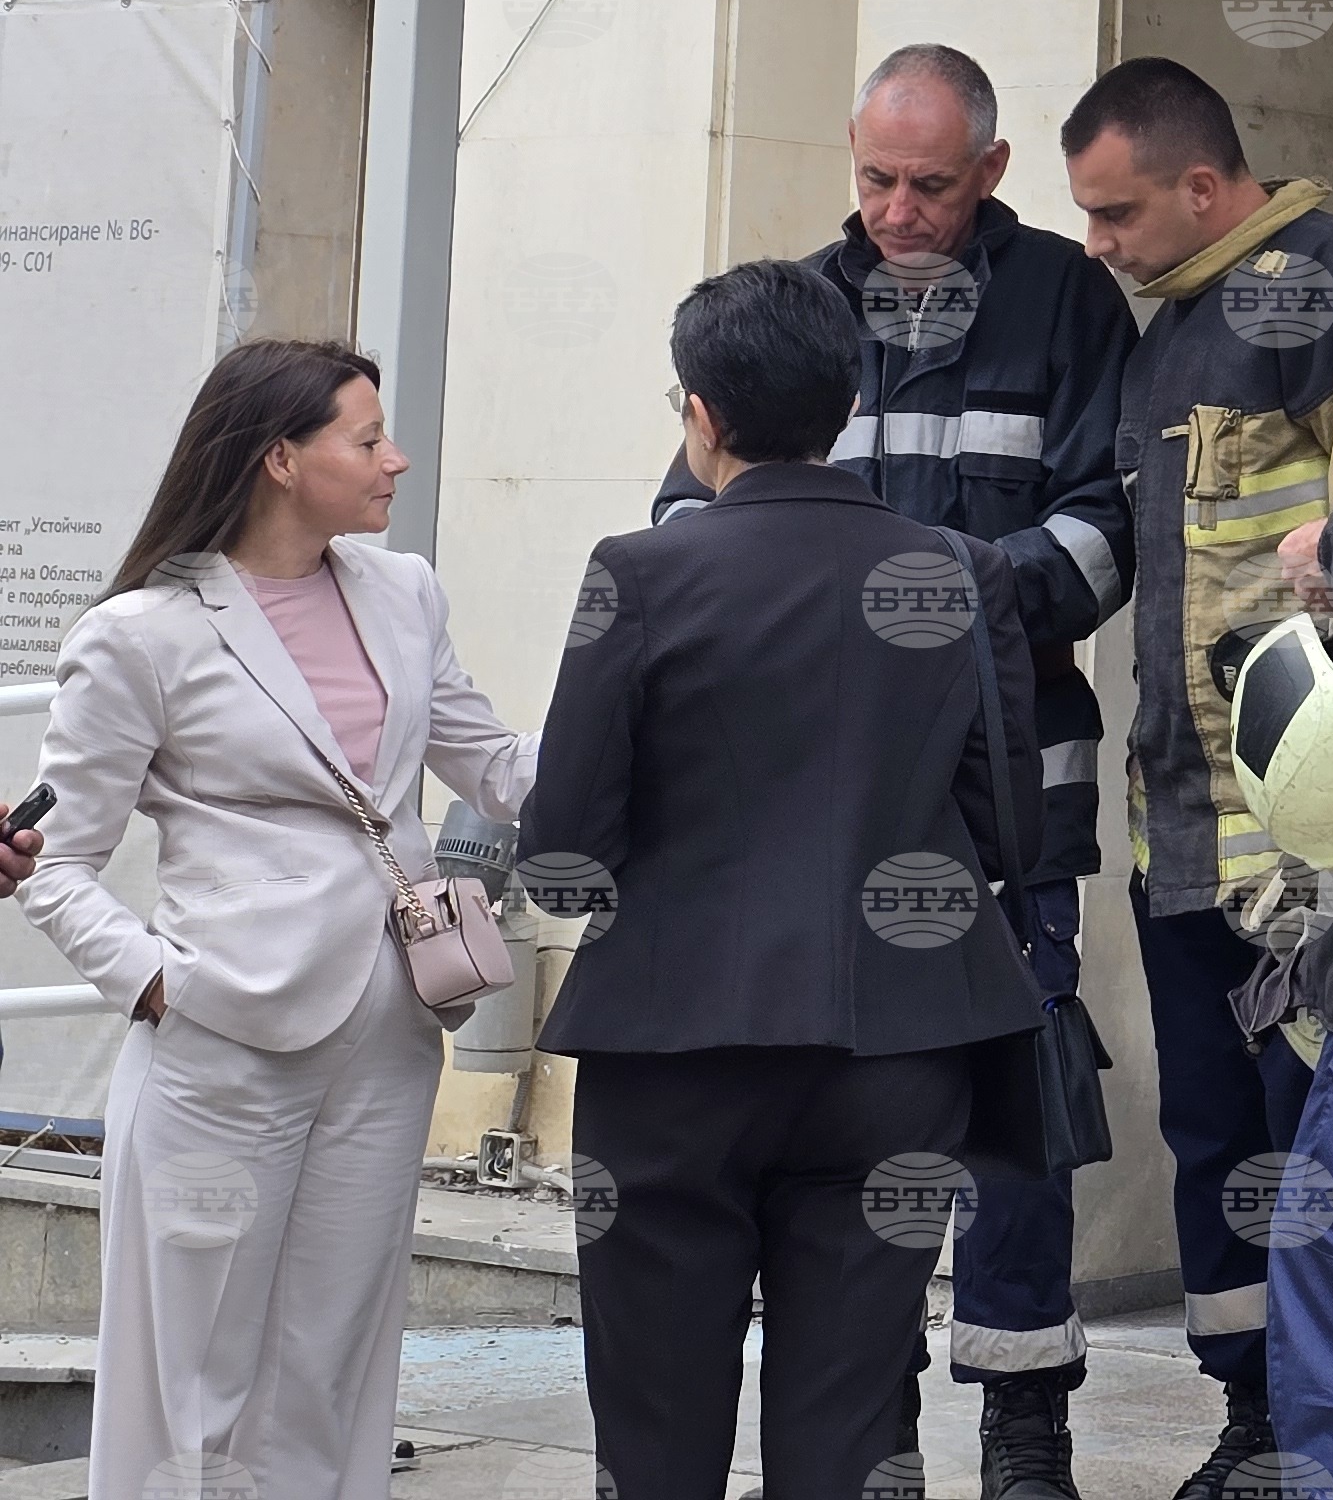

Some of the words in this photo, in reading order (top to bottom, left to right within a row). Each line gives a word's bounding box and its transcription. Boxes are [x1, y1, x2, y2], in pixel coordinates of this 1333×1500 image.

[106, 219, 123, 241] №
[129, 218, 160, 241] BG-
[0, 251, 17, 272] 9-
[7, 544, 23, 556] на
[20, 568, 36, 580] на
[39, 564, 103, 582] Областна
[45, 617, 60, 629] на
